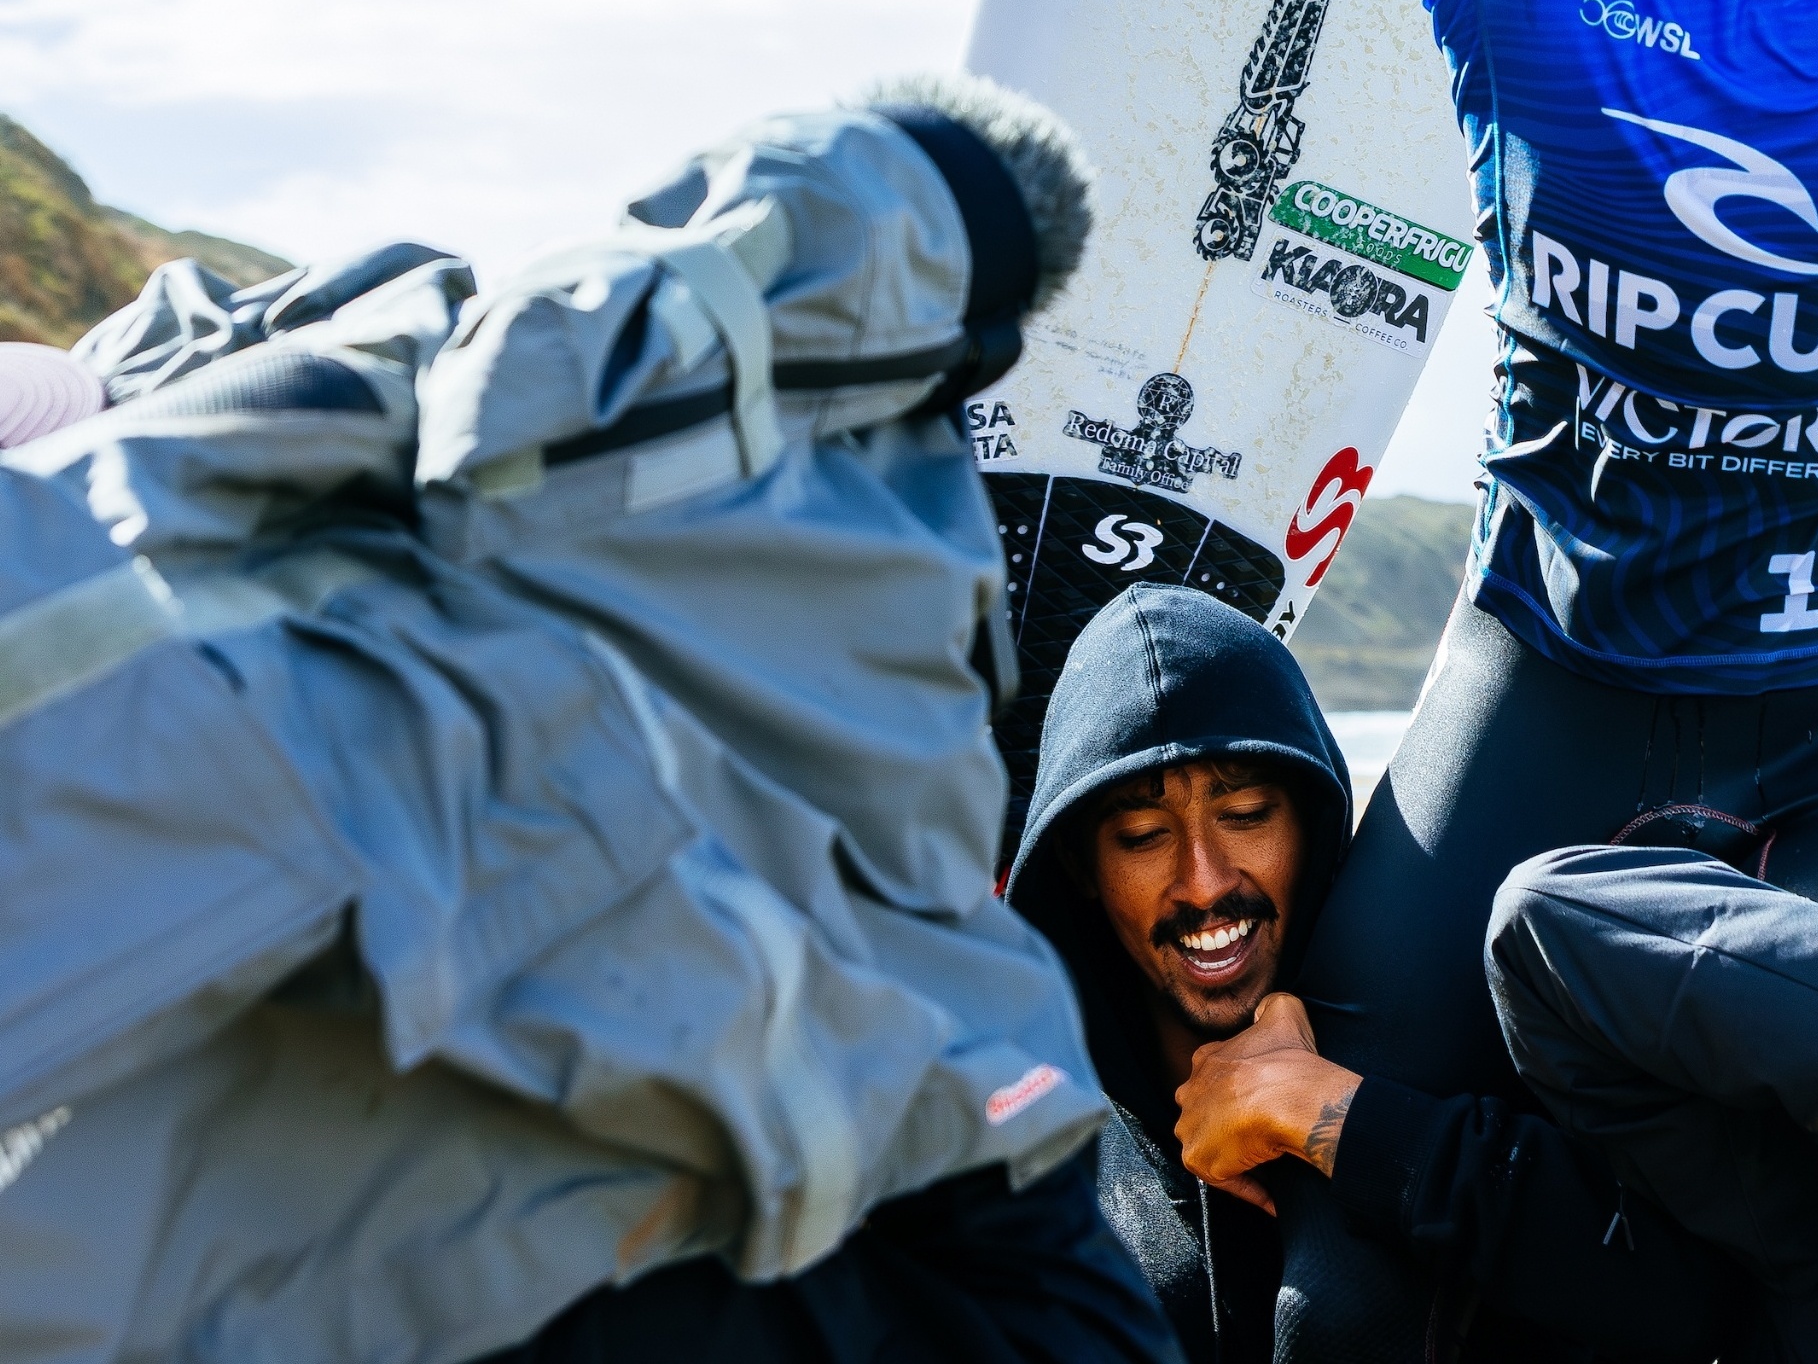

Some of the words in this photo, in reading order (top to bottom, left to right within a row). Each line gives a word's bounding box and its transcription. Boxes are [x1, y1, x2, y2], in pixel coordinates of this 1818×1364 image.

[1532, 231, 1681, 350] RIP
[1355, 323, 1393, 344] COFFEE
[1067, 412, 1158, 457] Redoma
[1164, 439, 1242, 477] Capital
[1581, 421, 1660, 463] EVERY
[1668, 452, 1714, 470] BIT
[1101, 457, 1147, 483] Family
